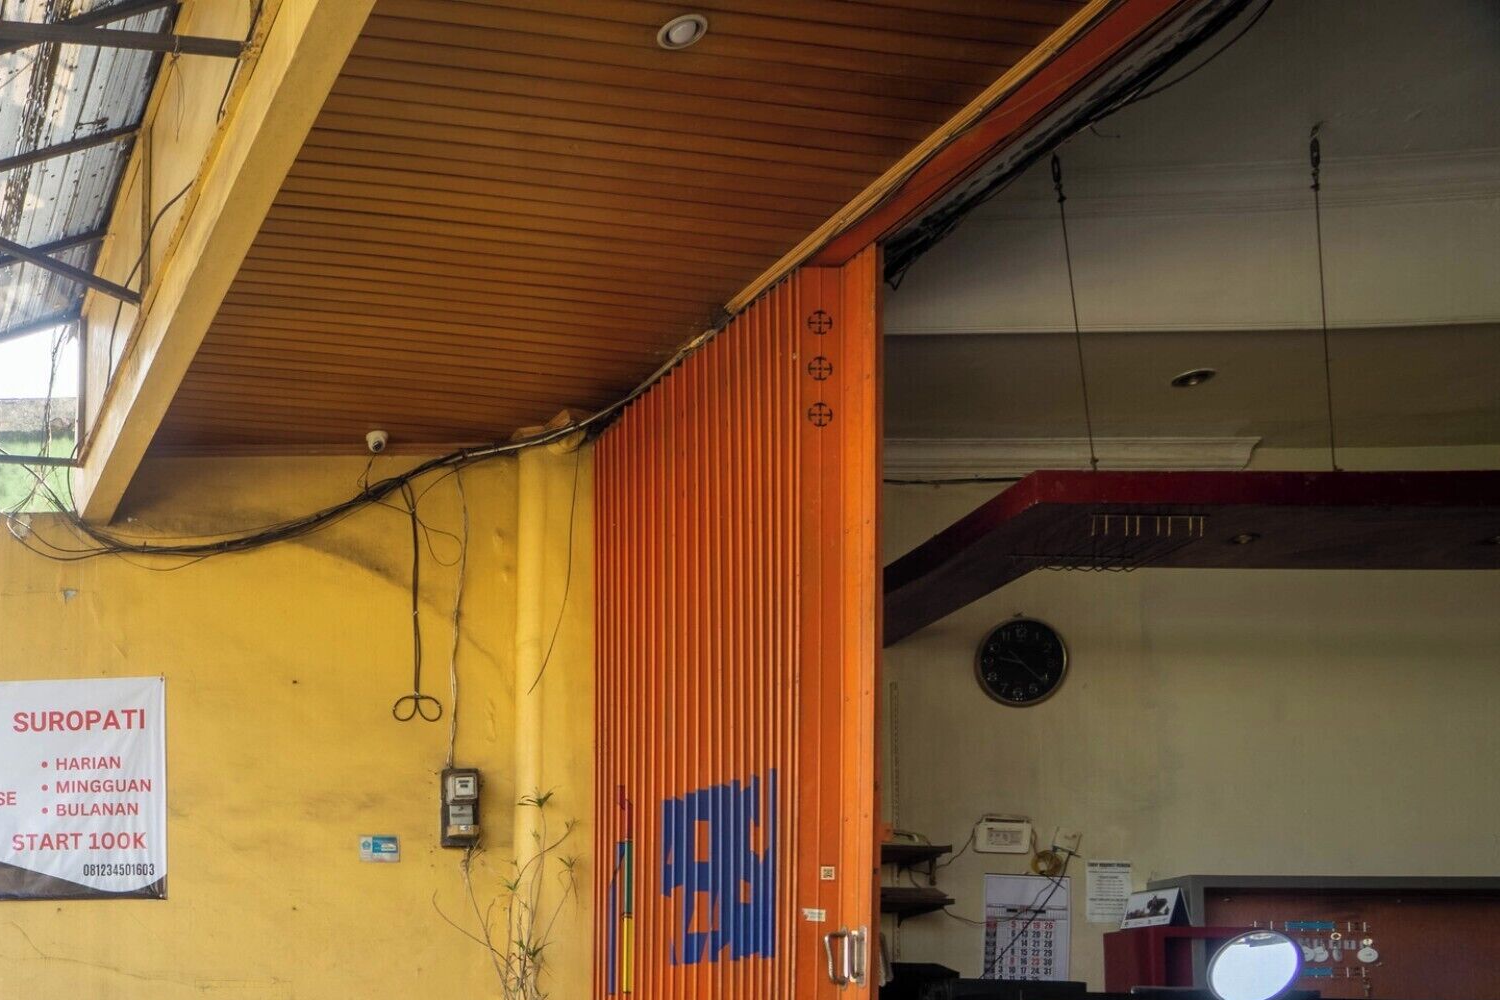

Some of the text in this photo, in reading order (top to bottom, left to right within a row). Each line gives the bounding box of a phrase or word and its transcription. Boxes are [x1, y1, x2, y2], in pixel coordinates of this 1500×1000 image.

[13, 709, 145, 732] SUROPATI
[56, 756, 121, 770] HARIAN
[56, 779, 151, 793] MINGGUAN
[56, 803, 139, 816] BULANAN
[12, 831, 147, 851] START 100K
[83, 863, 155, 876] 081234501603
